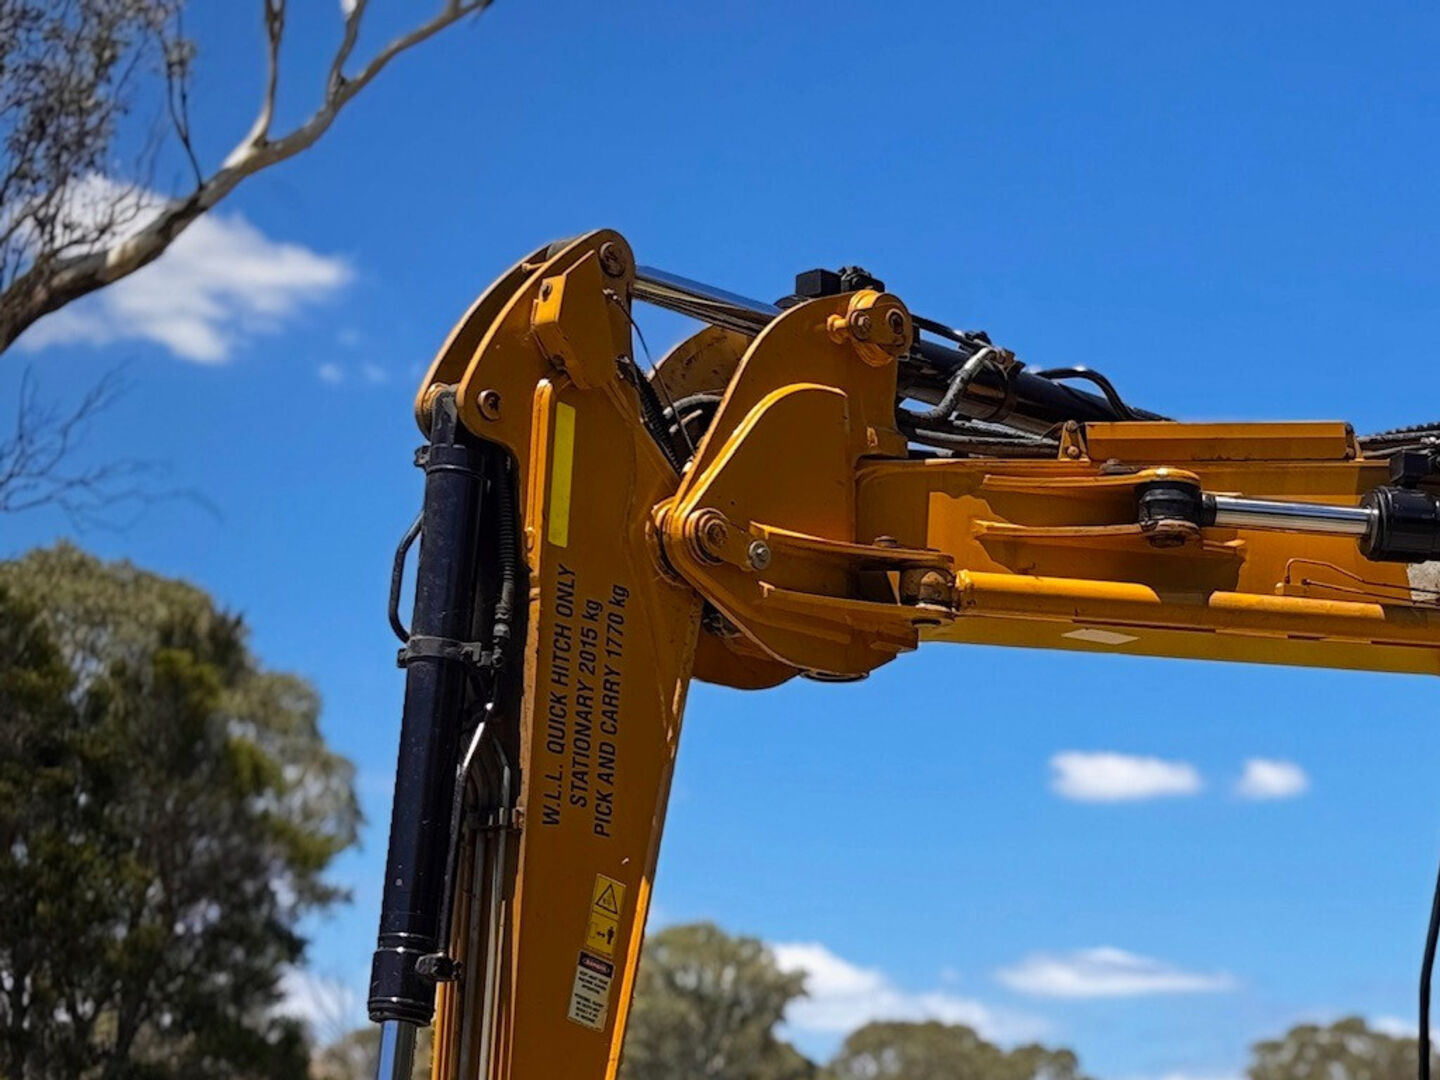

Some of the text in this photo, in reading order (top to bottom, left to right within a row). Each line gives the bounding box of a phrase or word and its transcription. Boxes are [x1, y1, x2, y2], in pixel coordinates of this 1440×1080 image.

[542, 563, 576, 825] W.L.L. QUICK HITCH ONLY
[569, 599, 604, 808] STATIONARY 2015 kg
[593, 584, 631, 838] PICK AND CARRY 1770 kg
